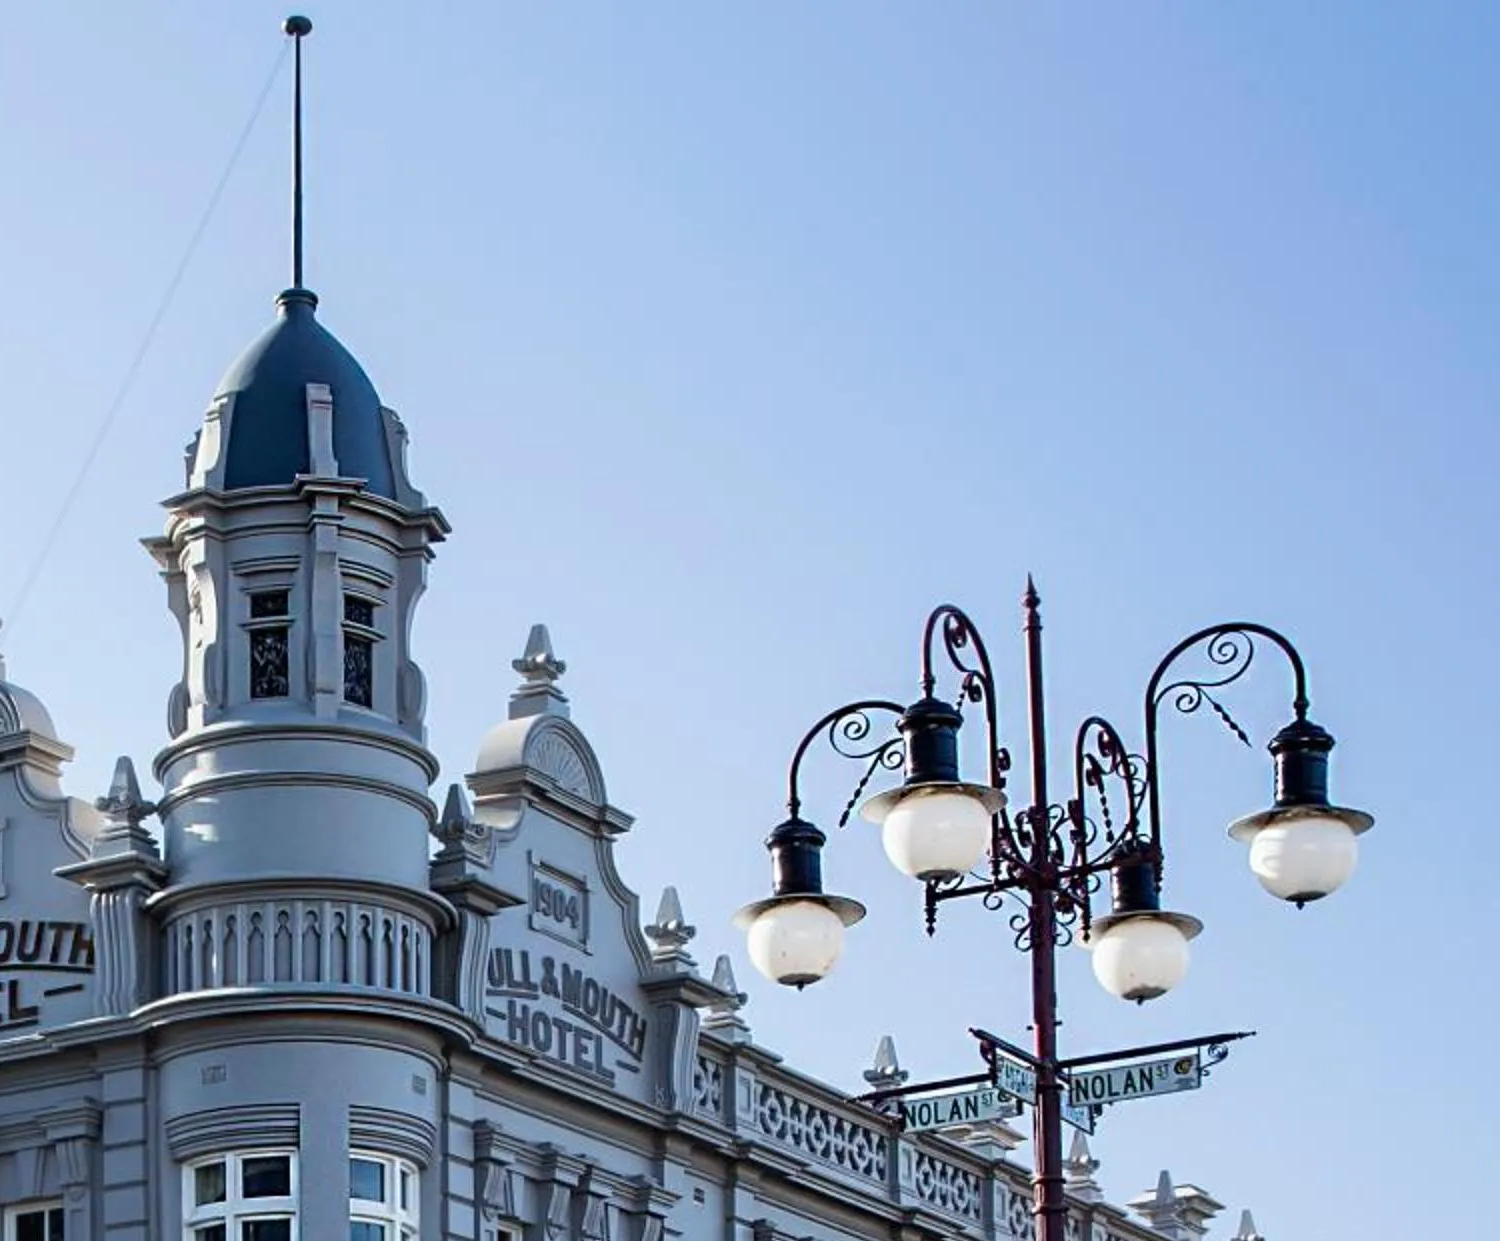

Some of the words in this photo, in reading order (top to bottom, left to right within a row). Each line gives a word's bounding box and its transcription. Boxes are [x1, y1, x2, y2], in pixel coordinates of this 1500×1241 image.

[534, 877, 581, 929] 1904
[486, 947, 538, 992] ULL
[541, 956, 560, 999] &
[562, 963, 647, 1059] MOUTH
[507, 999, 615, 1078] HOTEL
[1074, 1067, 1154, 1102] NOLAN
[1155, 1064, 1169, 1077] ST
[903, 1095, 979, 1128] NOLAN
[982, 1092, 994, 1106] ST
